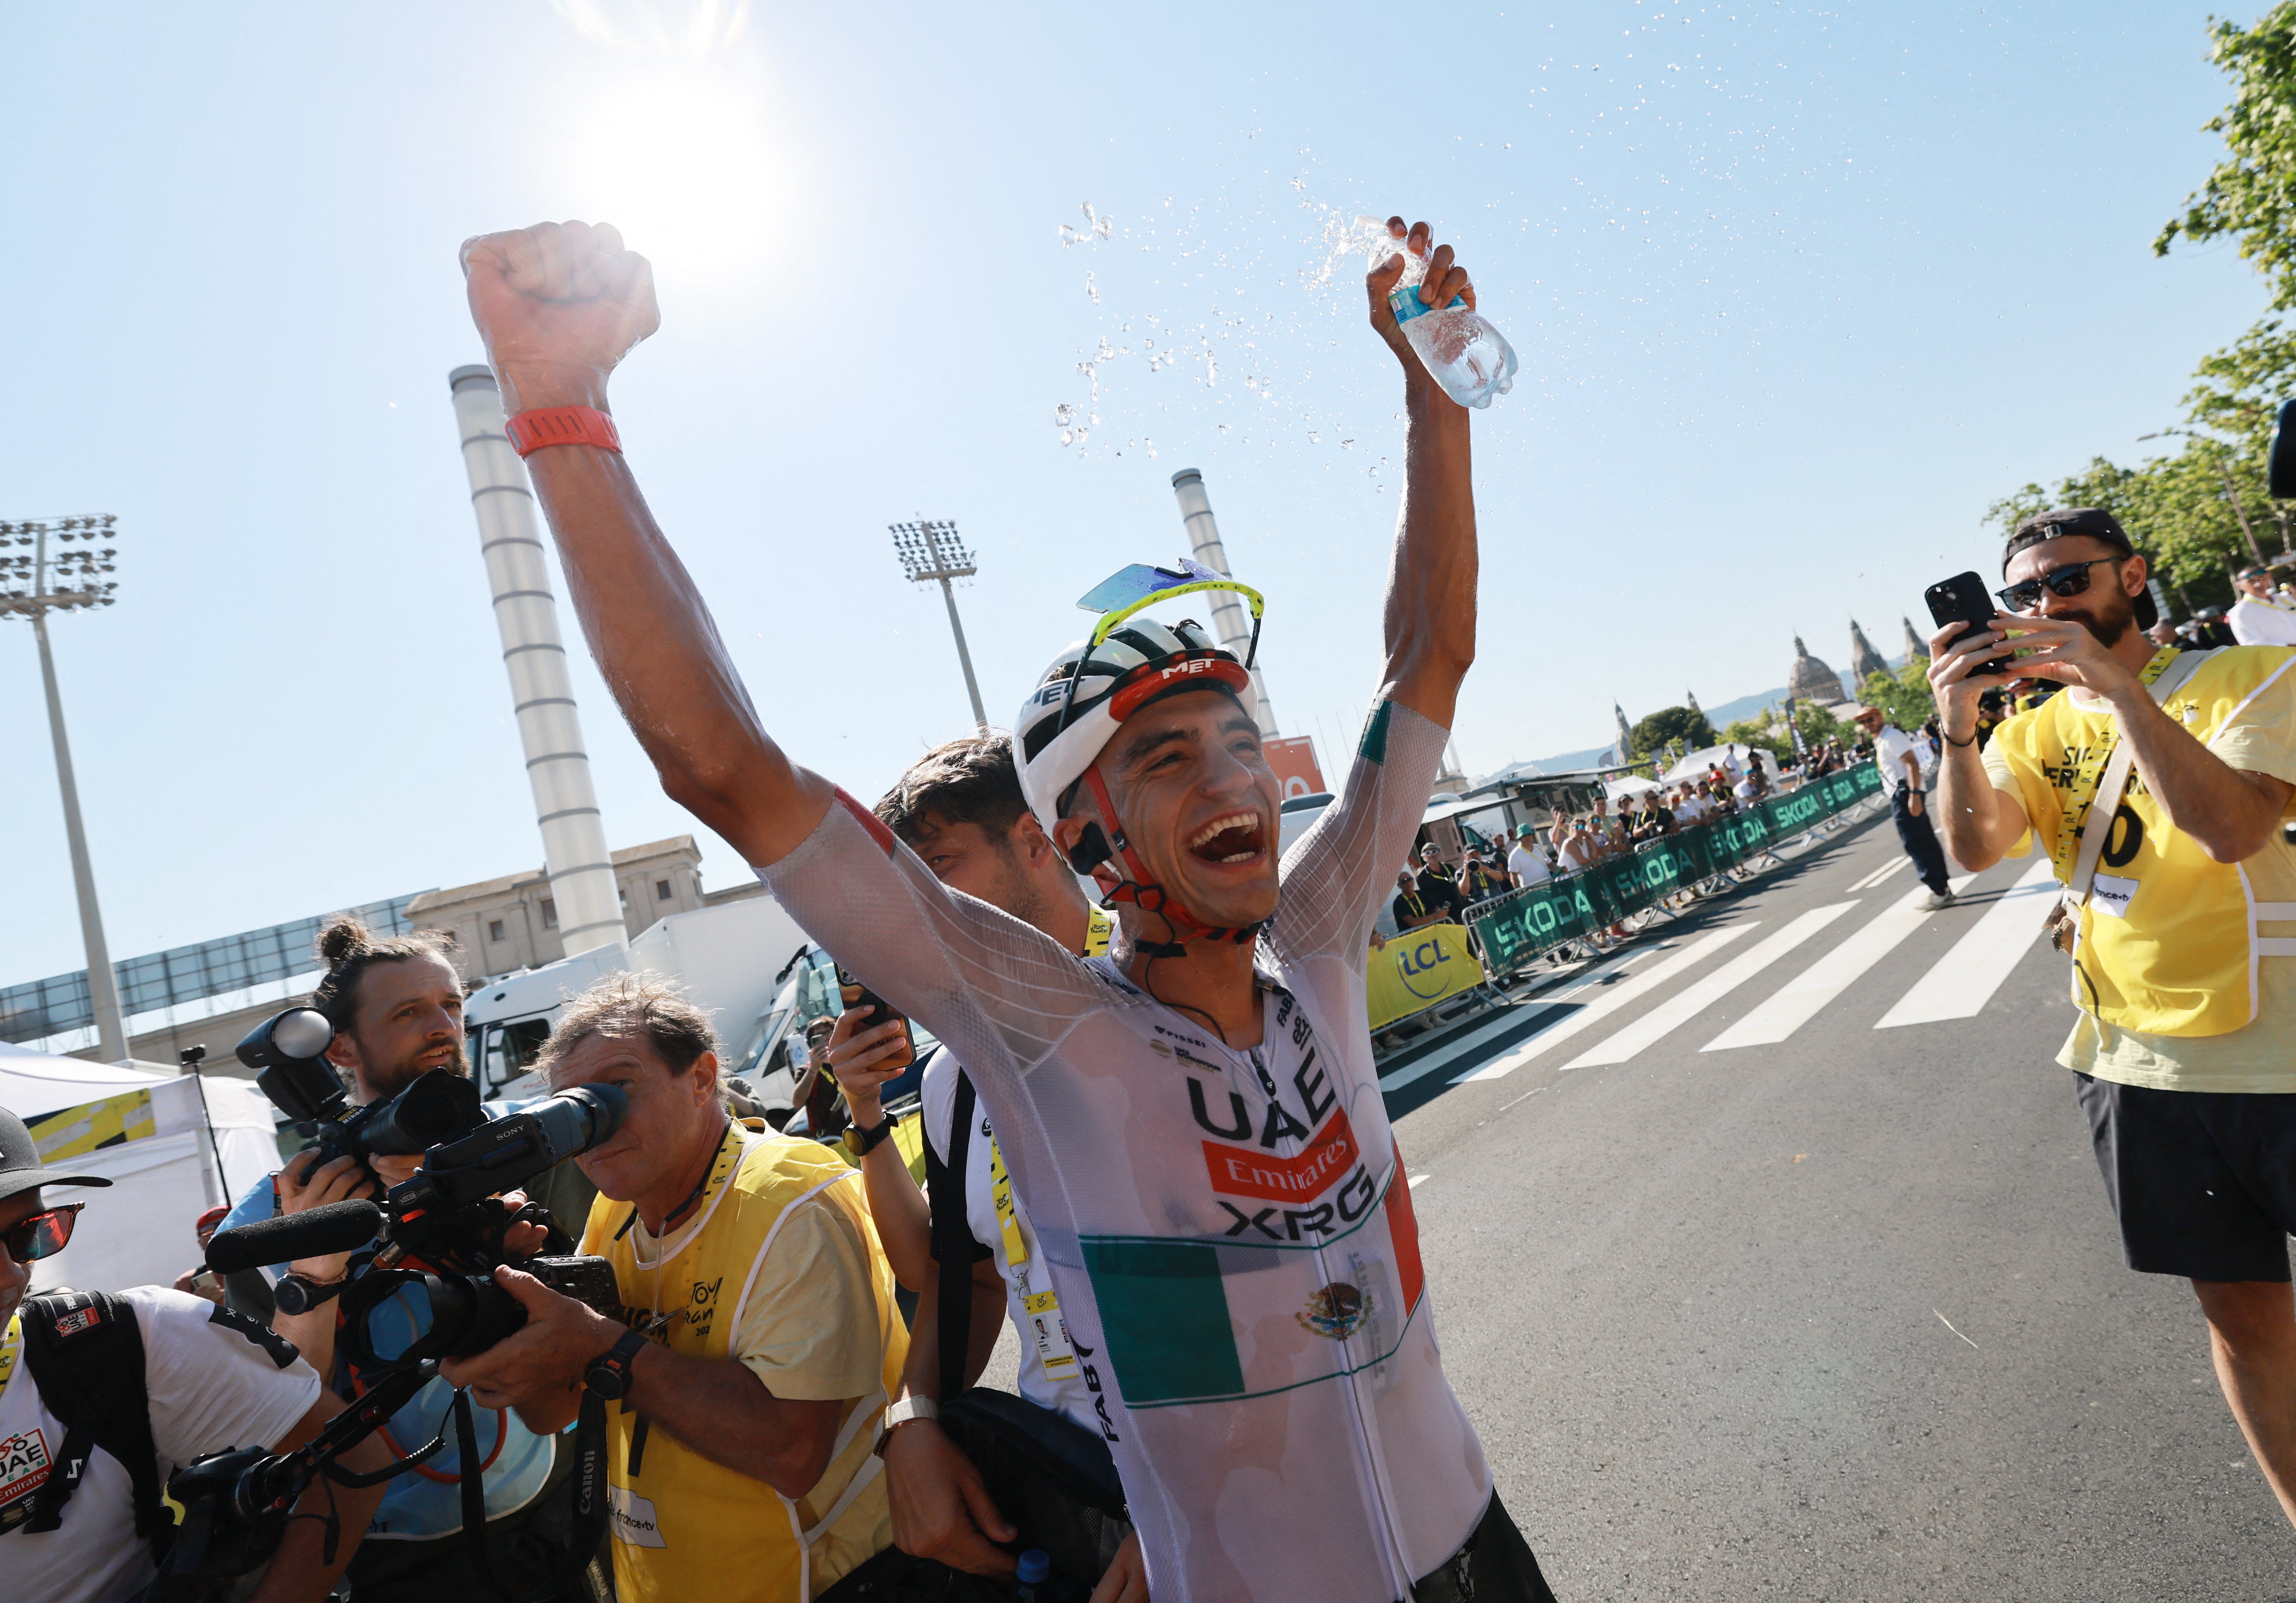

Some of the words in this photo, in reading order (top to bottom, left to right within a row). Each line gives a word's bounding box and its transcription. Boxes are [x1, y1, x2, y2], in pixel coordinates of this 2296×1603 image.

[1161, 658, 1215, 680] MET
[1400, 939, 1451, 976] LCL
[1166, 1031, 1206, 1048] PISSEI
[1187, 1046, 1336, 1148] UAE
[342, 1108, 365, 1124] Nikon
[497, 1125, 524, 1141] SONY
[1225, 1133, 1347, 1191] Emirates
[1218, 1163, 1374, 1241] XRG
[68, 1314, 81, 1331] UAE
[695, 1326, 710, 1336] 202
[1083, 1364, 1120, 1442] FAB
[580, 1450, 595, 1515] Canon
[22, 1495, 35, 1504] UCI
